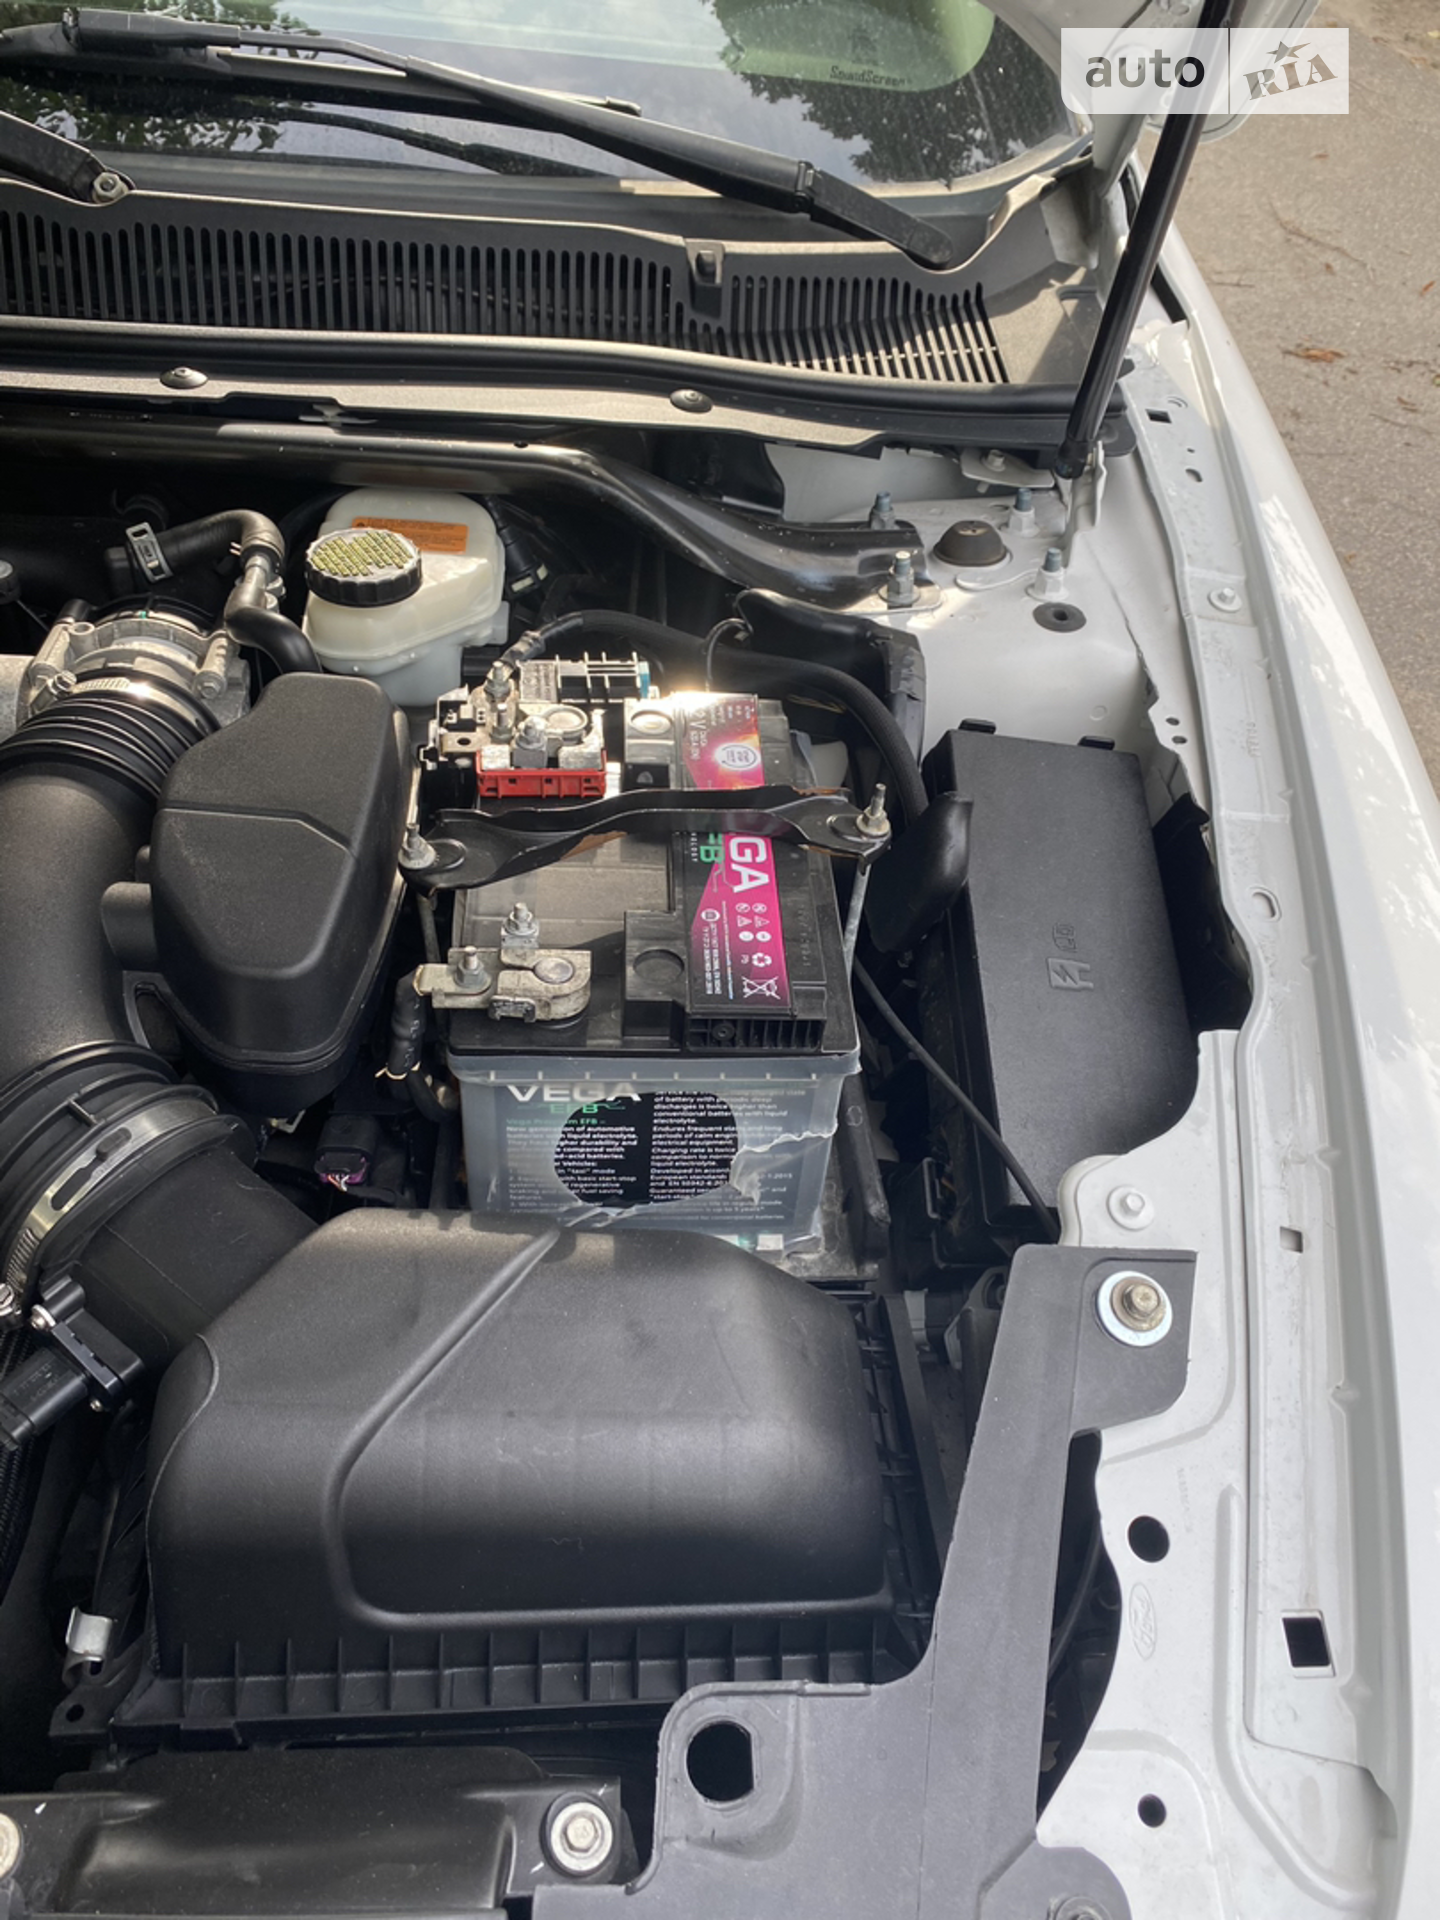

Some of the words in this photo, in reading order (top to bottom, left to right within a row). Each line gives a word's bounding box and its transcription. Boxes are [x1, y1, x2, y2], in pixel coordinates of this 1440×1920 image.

[730, 836, 770, 894] GA
[506, 1083, 642, 1102] VEGA
[666, 1096, 696, 1105] battery
[549, 1103, 599, 1114] EFB
[654, 1103, 697, 1111] discharges
[653, 1110, 706, 1118] conventional
[580, 1117, 598, 1125] EFB
[653, 1117, 700, 1126] electrolyte.
[653, 1125, 687, 1133] Endures
[687, 1125, 722, 1133] frequent
[567, 1133, 591, 1141] liquid
[592, 1133, 640, 1141] electrolyte.
[652, 1132, 683, 1141] periods
[580, 1140, 620, 1149] durability
[652, 1139, 689, 1147] electrical
[689, 1139, 734, 1148] equipment.
[563, 1147, 604, 1155] compared
[651, 1146, 688, 1155] Charging
[650, 1153, 697, 1162] comparison
[650, 1160, 674, 1168] liquid
[674, 1160, 718, 1168] electrolyte.
[650, 1167, 694, 1175] Developed
[649, 1174, 688, 1182] European
[570, 1182, 621, 1190] regenerative
[598, 1188, 625, 1197] saving
[648, 1187, 696, 1195] Guaranteed
